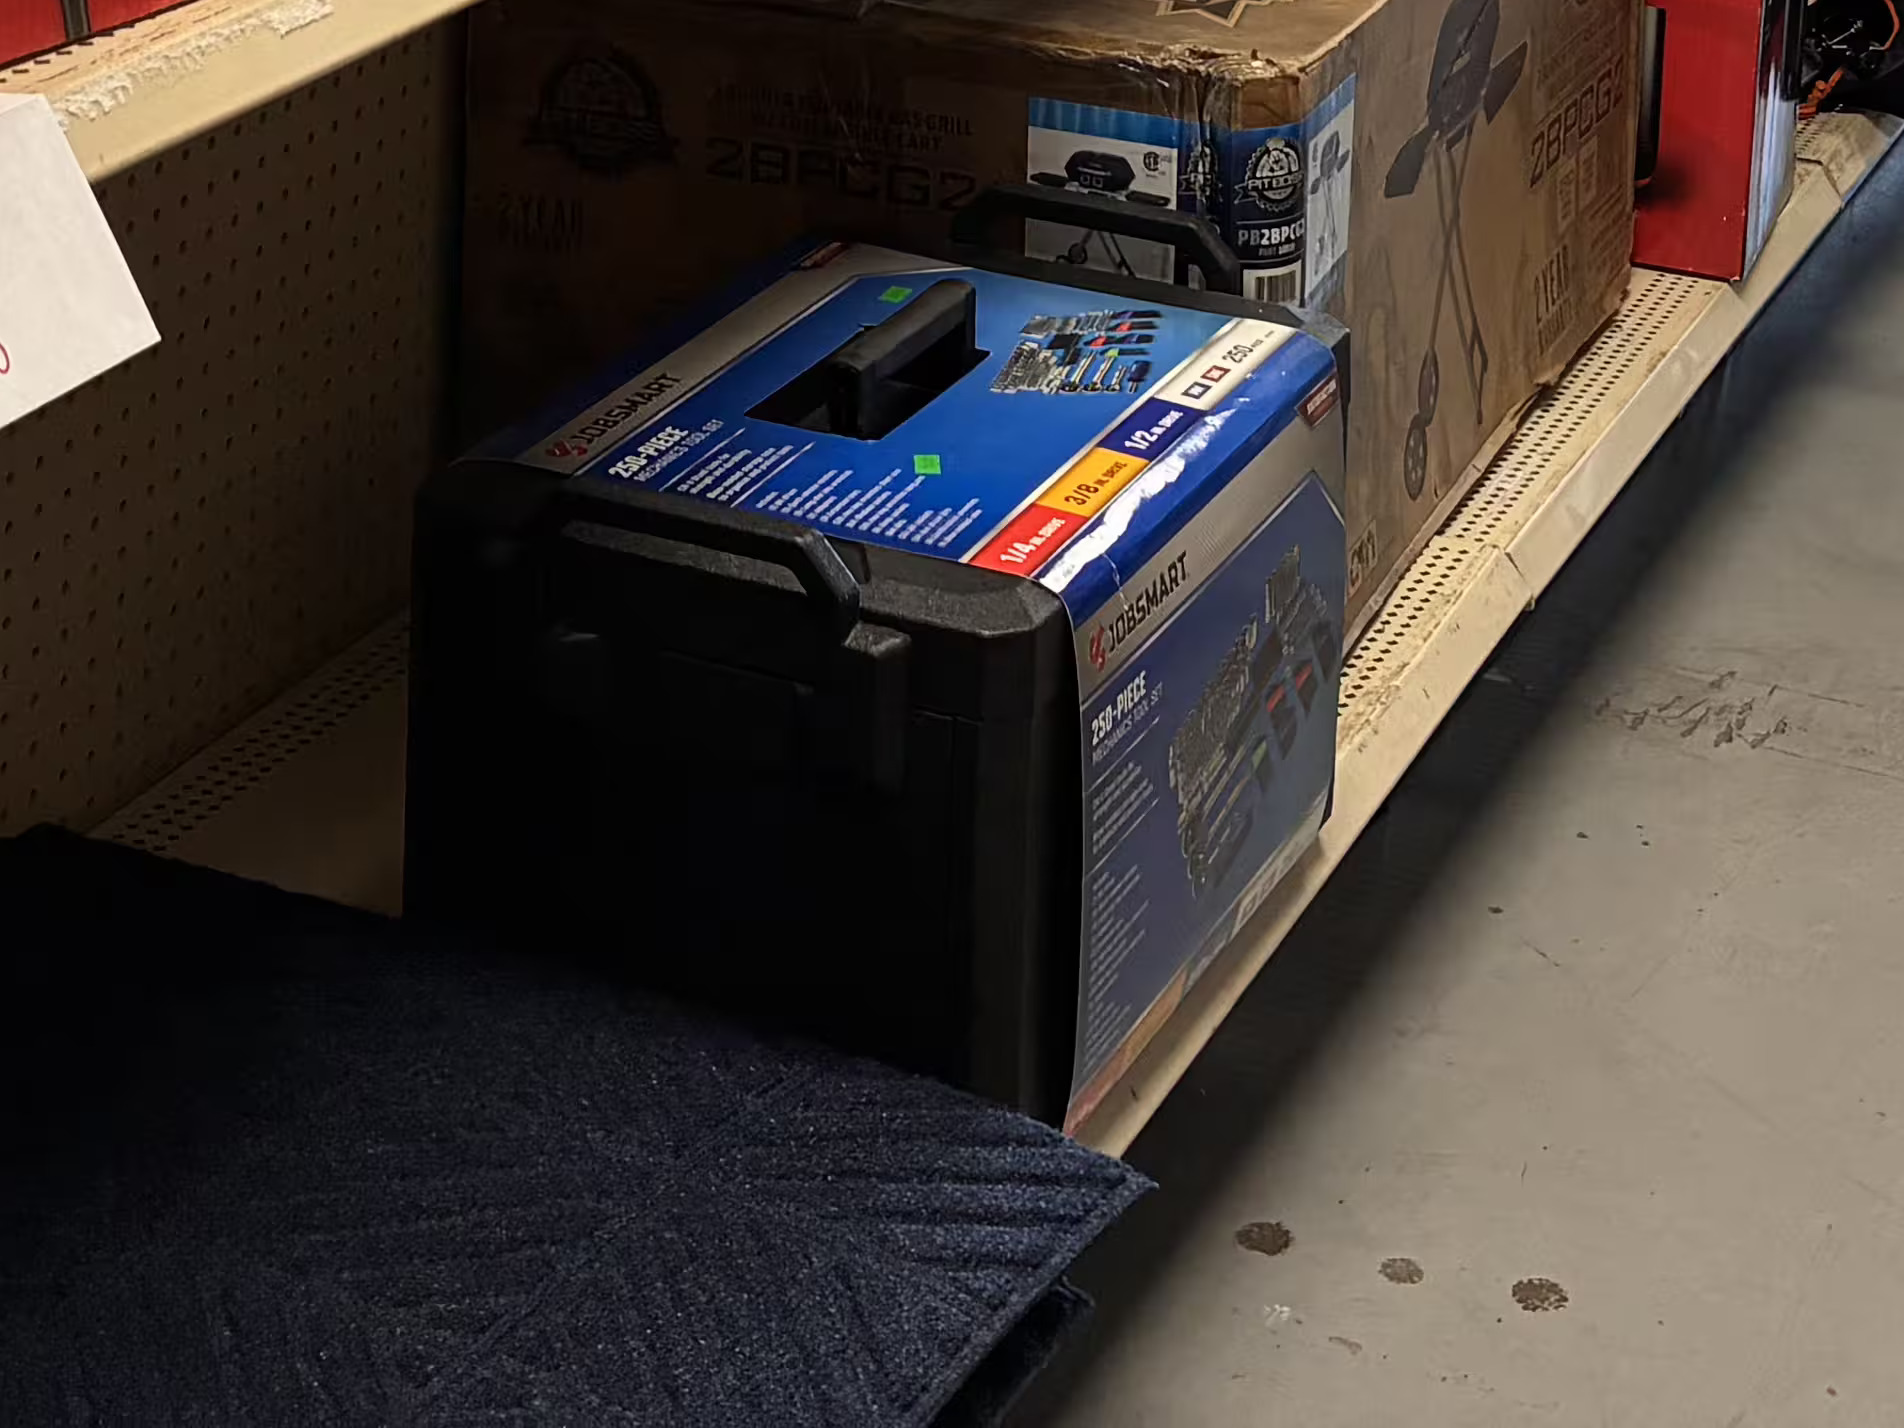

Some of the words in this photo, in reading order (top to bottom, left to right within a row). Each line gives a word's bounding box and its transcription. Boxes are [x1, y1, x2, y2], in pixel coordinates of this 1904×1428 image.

[1248, 176, 1272, 191] PIT
[1222, 342, 1253, 366] 250
[577, 371, 684, 447] JOBSMART
[1123, 427, 1158, 452] 1/2
[1161, 408, 1185, 430] DRIVE
[608, 423, 690, 480] 250-PIECE
[1063, 482, 1100, 509] 3/8
[1106, 460, 1129, 483] DRIVE
[999, 535, 1034, 565] 1/4
[1042, 515, 1067, 540] DRIVE
[1107, 549, 1190, 656] JOBSMART
[1090, 669, 1148, 748] 250-PIECE
[1092, 712, 1134, 767] MECHANICS
[1132, 697, 1151, 724] TOOL
